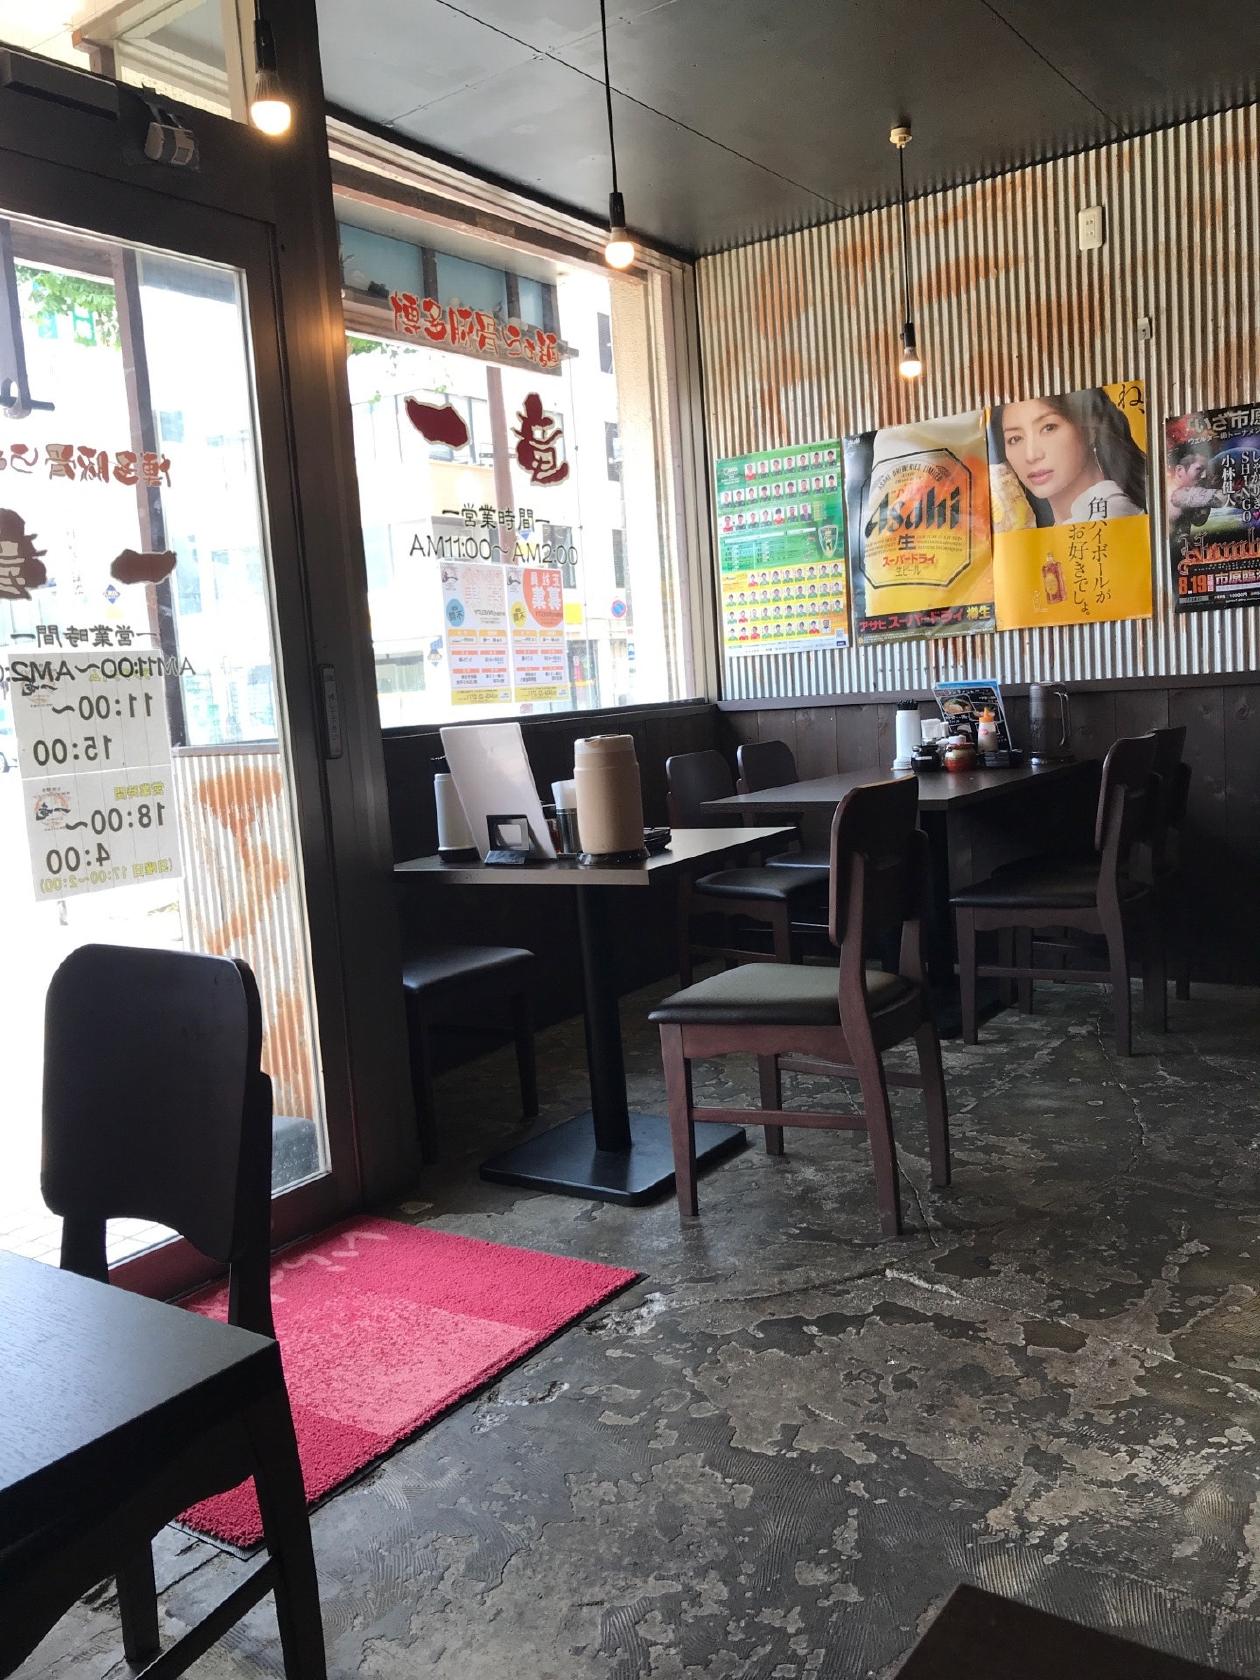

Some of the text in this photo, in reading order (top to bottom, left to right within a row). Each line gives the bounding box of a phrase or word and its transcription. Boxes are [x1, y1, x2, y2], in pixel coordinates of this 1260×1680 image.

[864, 486, 960, 538] Asahi
[898, 533, 916, 551] 生
[1088, 496, 1112, 604] 角ハイボールが
[882, 553, 936, 567] スーパードライ
[1068, 525, 1091, 615] お好きでしょ。
[1179, 574, 1207, 595] 8.19
[859, 620, 887, 632] アサヒ
[888, 607, 964, 629] スーパードライ
